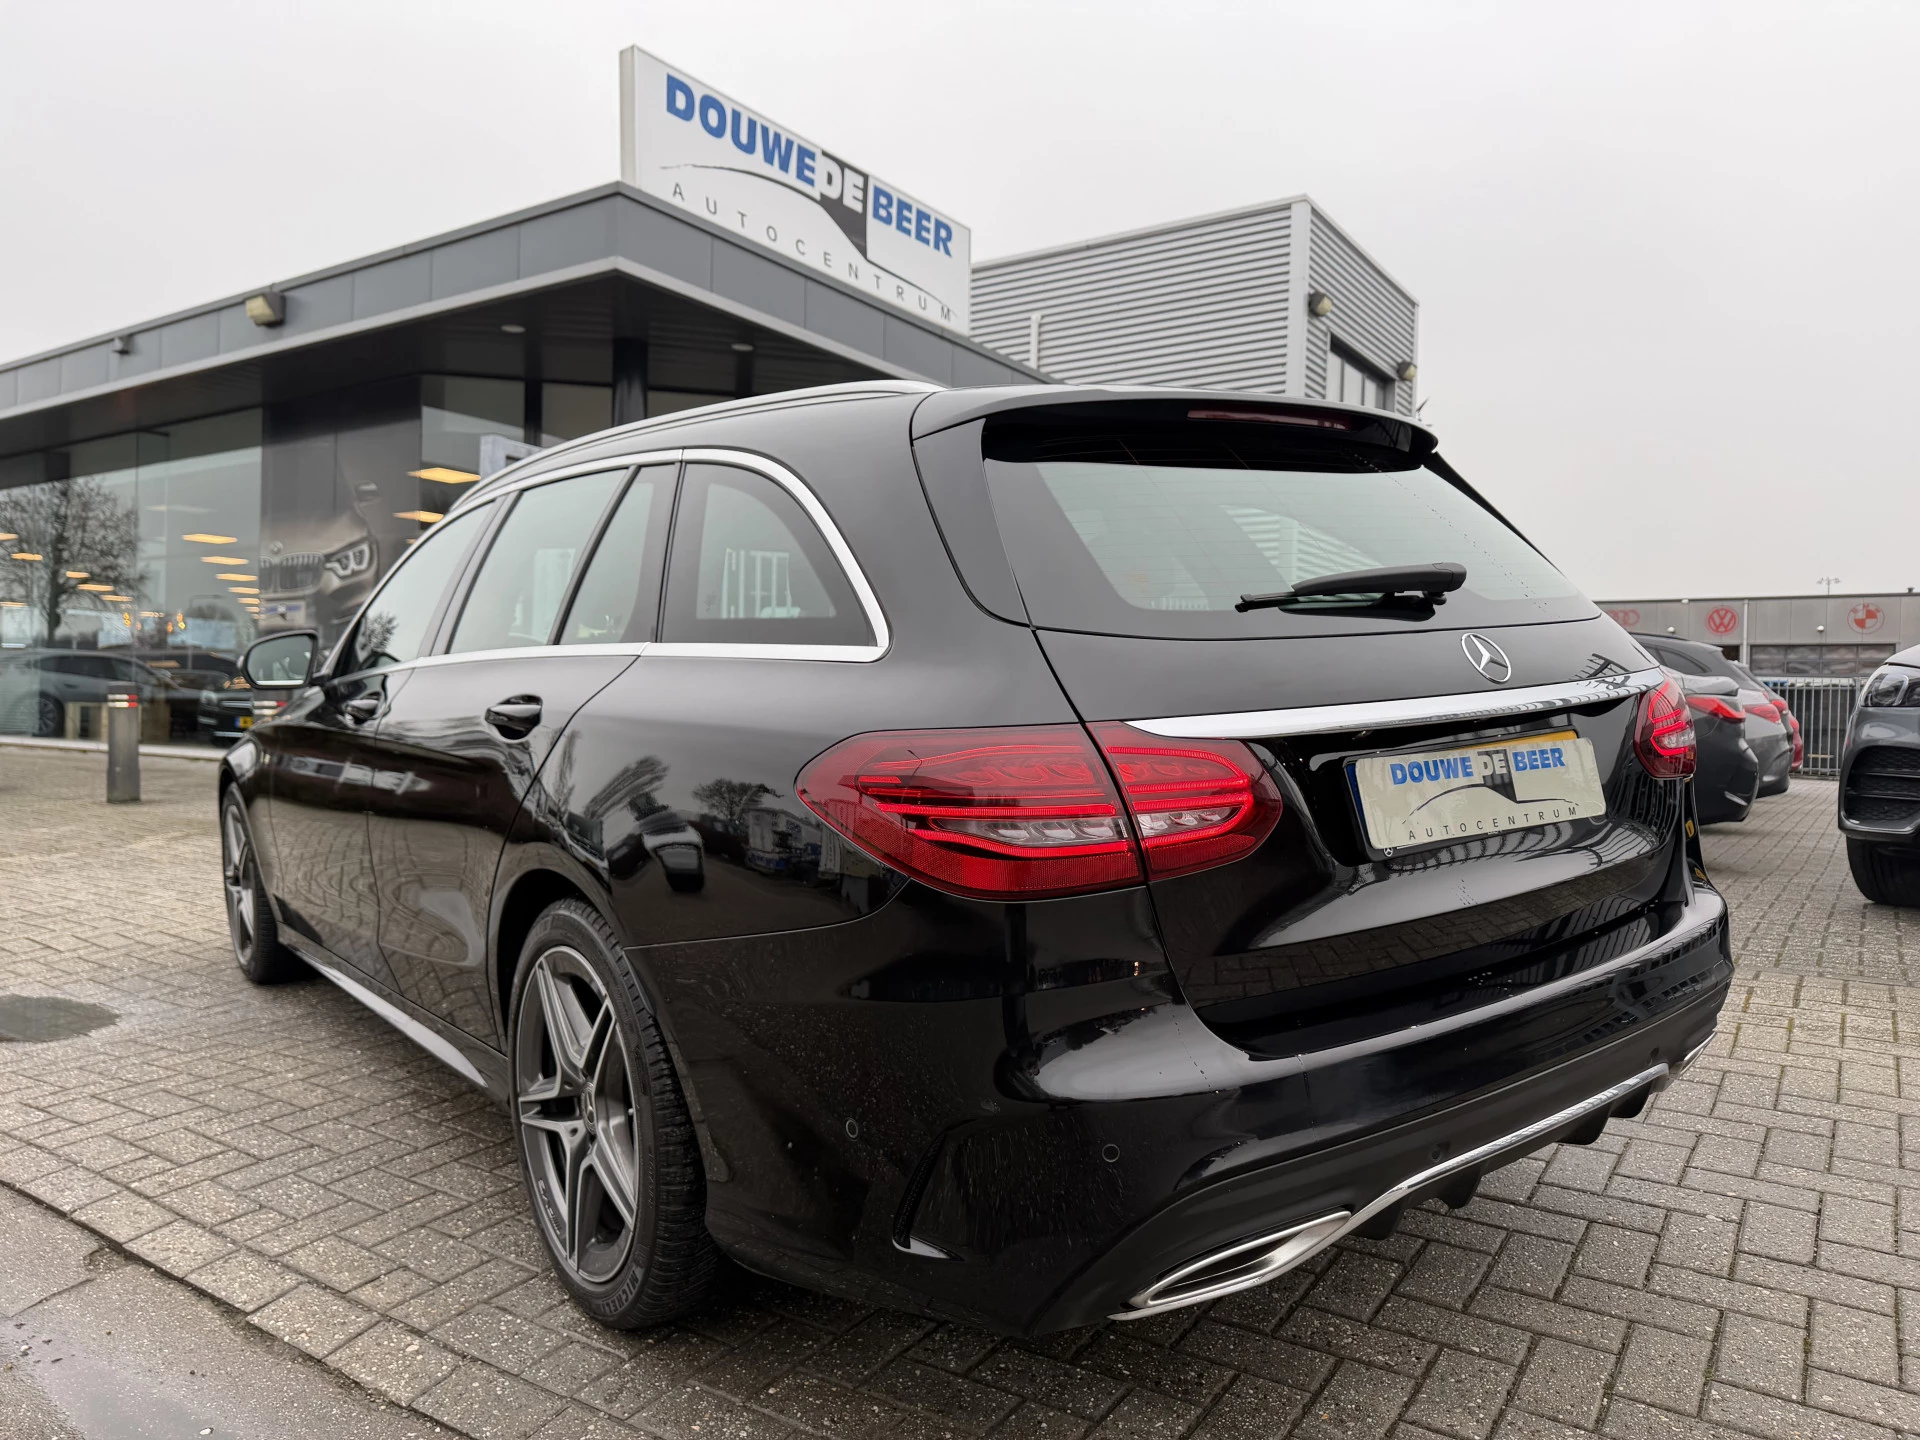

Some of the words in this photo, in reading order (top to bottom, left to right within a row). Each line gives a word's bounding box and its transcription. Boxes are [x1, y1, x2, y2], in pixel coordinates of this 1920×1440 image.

[666, 72, 816, 187] DOUWE
[819, 152, 864, 213] DE
[872, 184, 953, 258] BEER
[672, 182, 951, 322] AUTOCENTRUM
[1389, 756, 1474, 785] DOUWE
[1478, 752, 1507, 777] DE
[1511, 747, 1566, 772] BEER
[1408, 806, 1577, 840] AUTOCENTRUM
